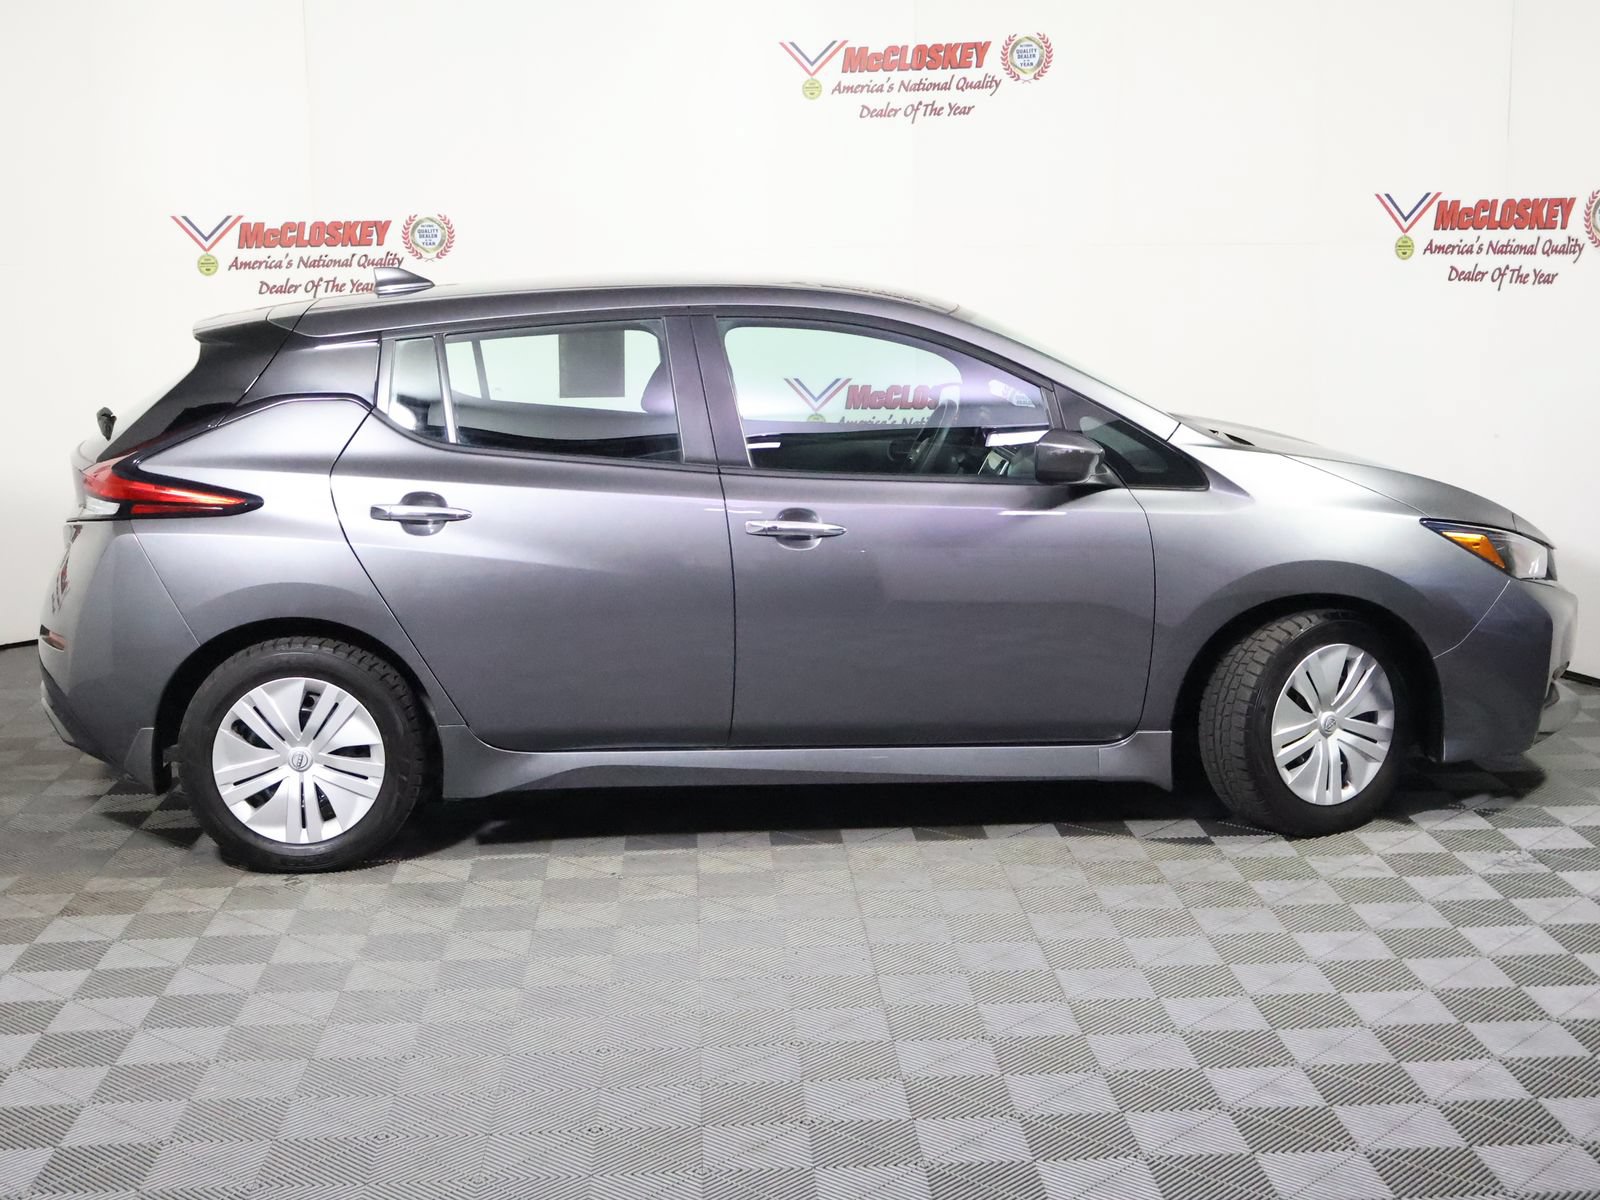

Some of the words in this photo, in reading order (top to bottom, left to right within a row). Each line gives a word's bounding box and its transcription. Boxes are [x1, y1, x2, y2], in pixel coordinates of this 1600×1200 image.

[841, 41, 992, 73] McCLOSKEY
[831, 76, 894, 95] America's
[897, 73, 955, 93] National
[955, 73, 1002, 96] Quality
[859, 102, 901, 118] Dealer
[922, 102, 944, 117] The
[947, 103, 975, 117] Year
[1433, 197, 1577, 230] McCLOSKEY
[237, 220, 392, 249] McCLOSKEY
[1423, 236, 1484, 255] America's
[1485, 235, 1540, 256] National
[1541, 236, 1585, 263] Quality
[228, 253, 294, 271] America's
[298, 252, 356, 269] National
[1447, 263, 1488, 282] Dealer
[1509, 265, 1530, 285] The
[1532, 268, 1558, 285] Year
[258, 279, 301, 295] Dealer
[322, 279, 346, 293] The
